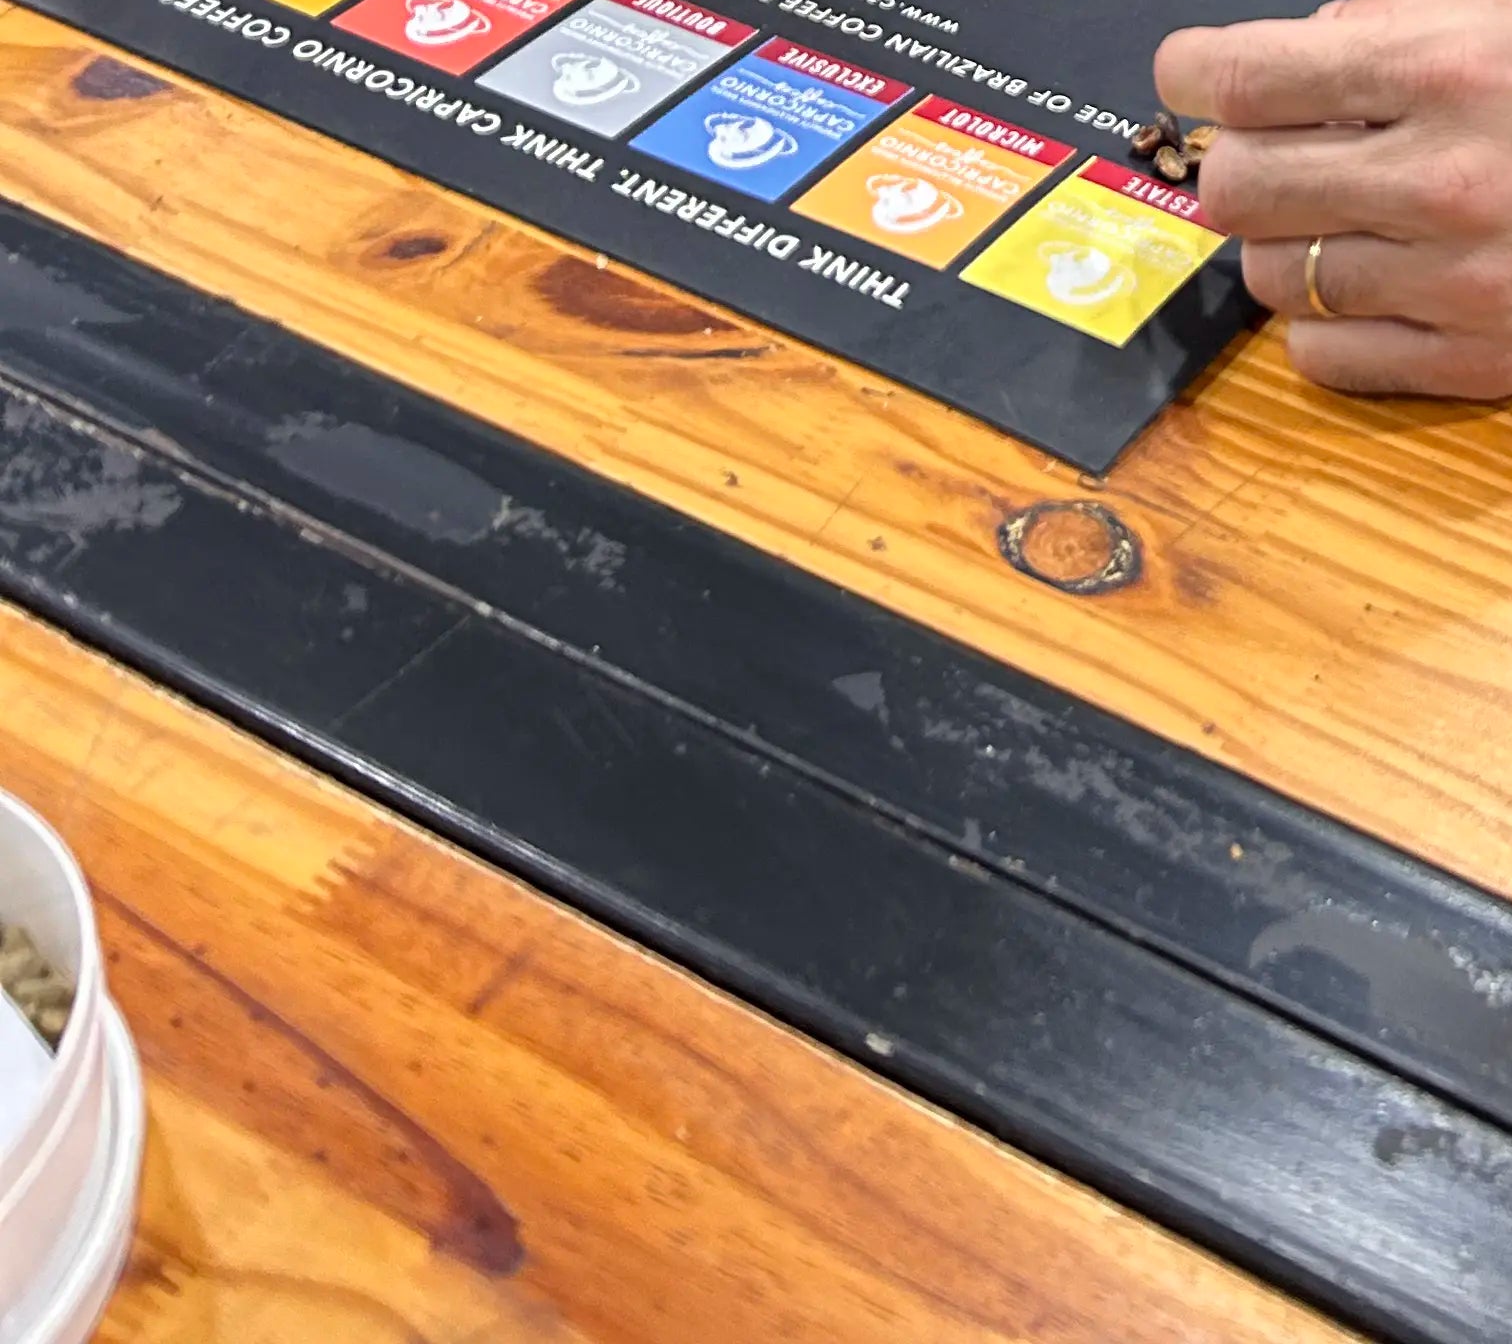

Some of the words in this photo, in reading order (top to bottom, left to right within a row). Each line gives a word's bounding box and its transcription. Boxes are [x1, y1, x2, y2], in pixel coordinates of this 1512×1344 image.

[568, 17, 699, 74] CAPRICORNIO
[777, 46, 888, 96] EXCLUSIVE
[884, 32, 1031, 98] BRAZILIAN
[292, 39, 502, 136] CAPRICORNIO
[720, 75, 857, 137] CAPRICORNIO
[1027, 88, 1073, 114] OF
[939, 107, 1046, 155] MICROLOT
[1075, 103, 1141, 139] NGE
[500, 123, 605, 184] THINK
[879, 135, 1022, 199] CAPRICORNIO
[611, 167, 802, 261] DIFFERENT.
[1122, 176, 1200, 216] ESTATE
[799, 244, 911, 310] THINK
